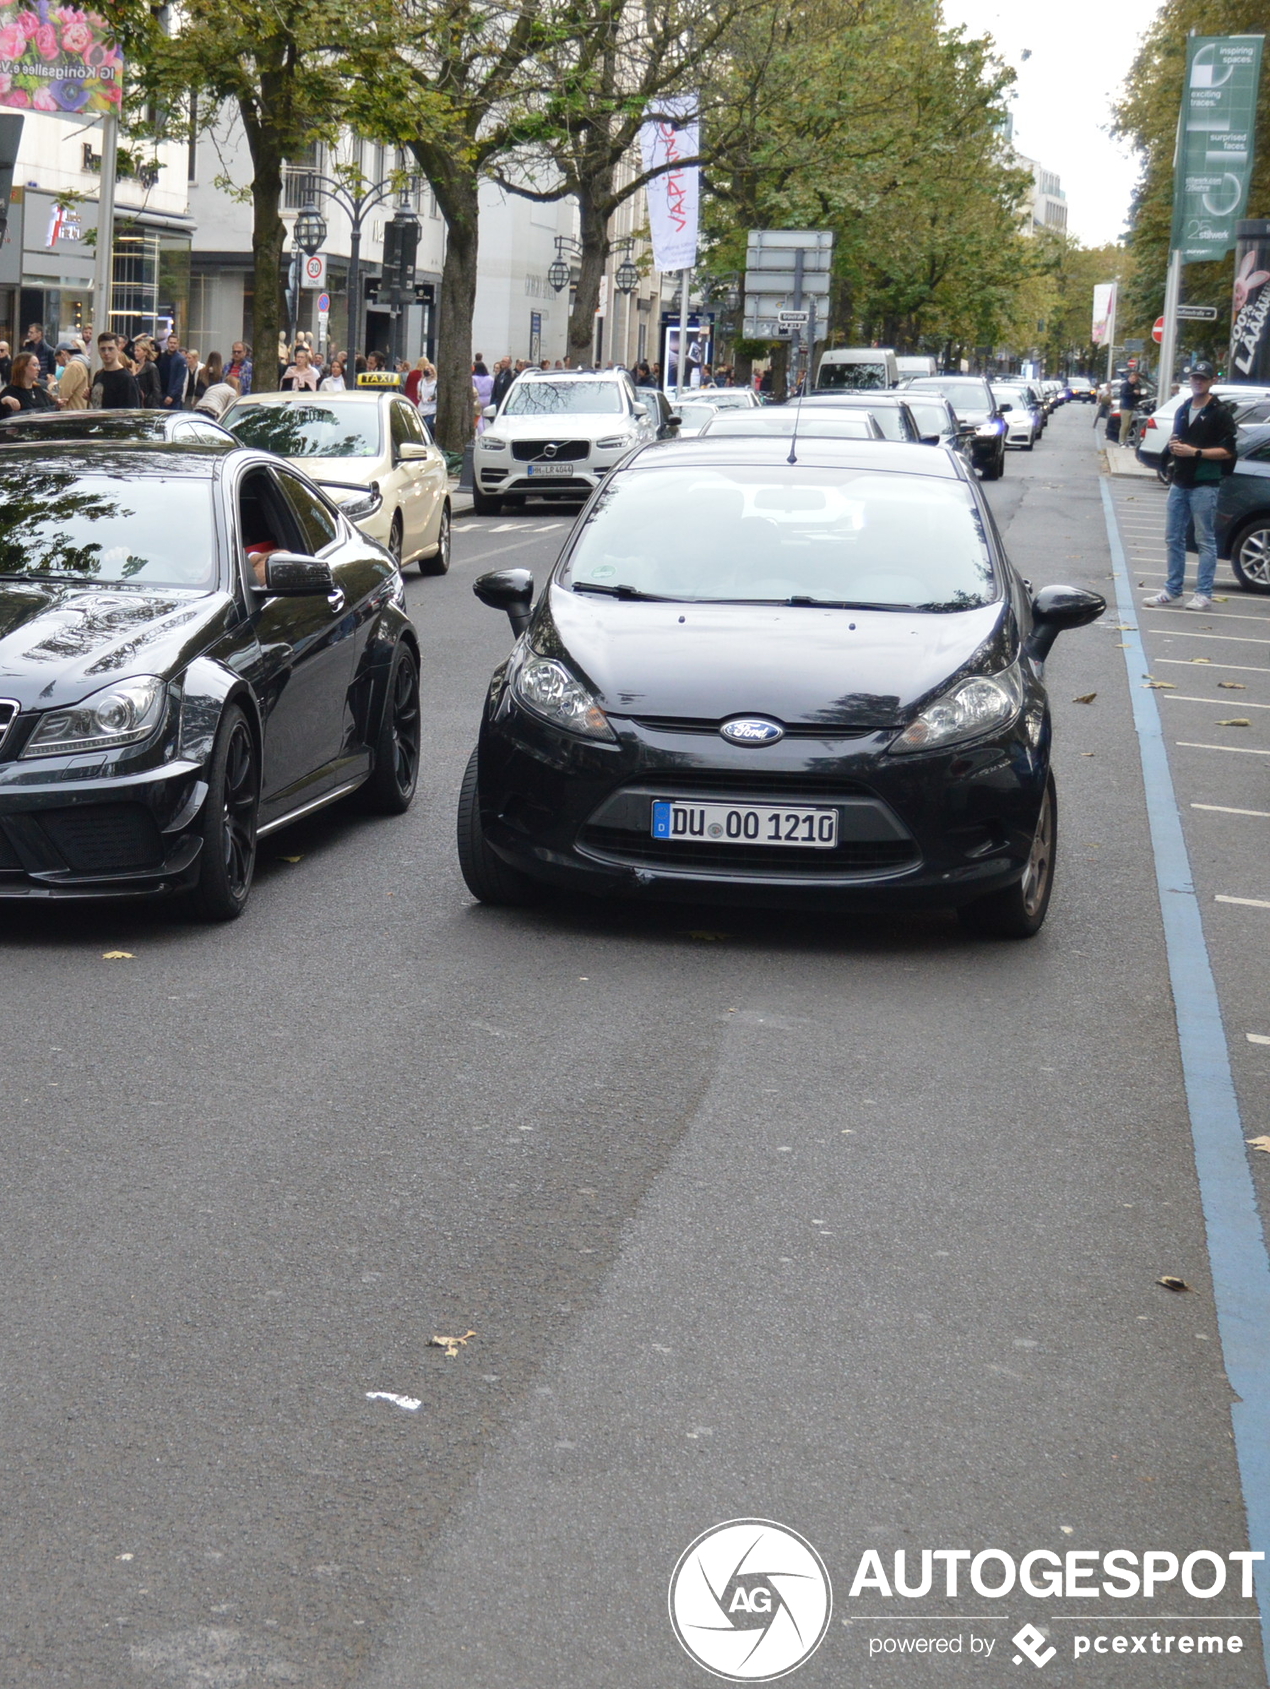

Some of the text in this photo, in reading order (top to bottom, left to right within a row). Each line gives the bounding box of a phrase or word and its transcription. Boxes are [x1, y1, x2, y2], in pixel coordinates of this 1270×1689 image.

[1220, 46, 1253, 56] inspiring
[1222, 56, 1252, 64] spaces.
[1191, 90, 1221, 99] exciting
[1190, 99, 1216, 107] traces.
[1210, 133, 1247, 142] surprised
[1223, 142, 1246, 150] faces.
[309, 262, 319, 273] 30
[365, 374, 393, 383] TAXI
[733, 722, 770, 740] Ford
[658, 823, 665, 832] D
[672, 807, 705, 836] DU
[767, 813, 834, 843] 1210
